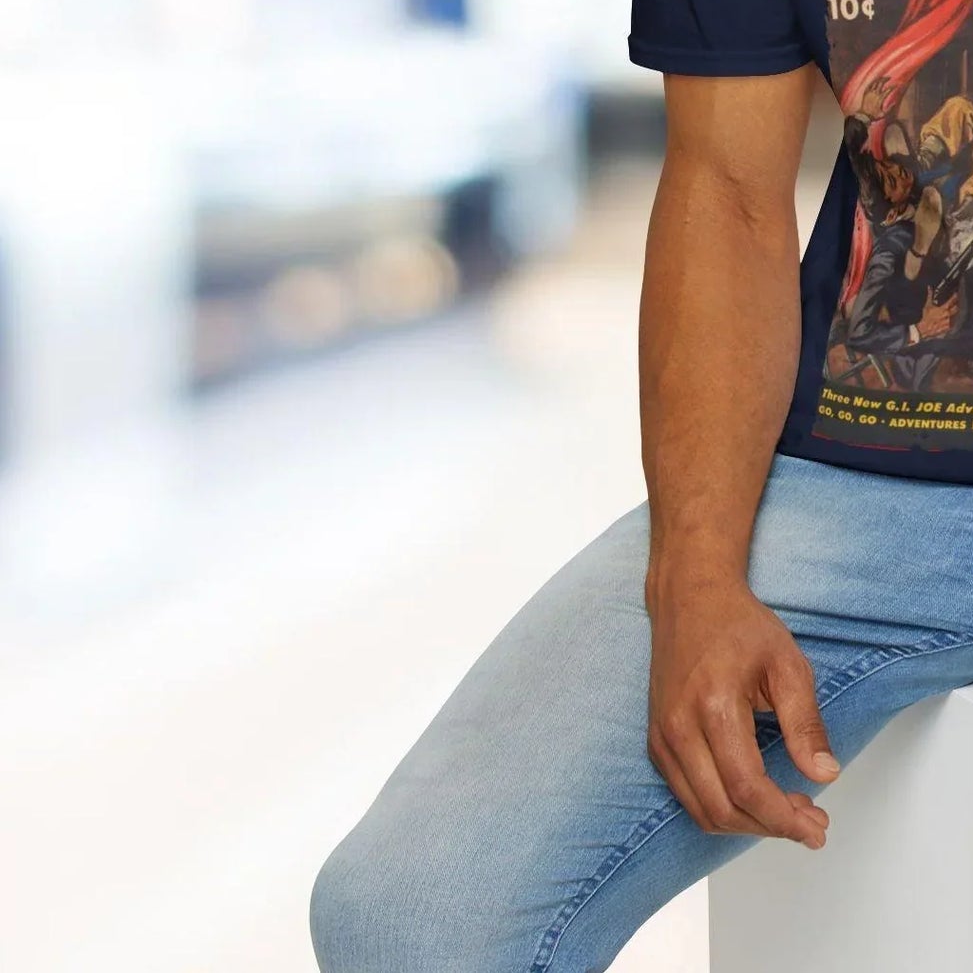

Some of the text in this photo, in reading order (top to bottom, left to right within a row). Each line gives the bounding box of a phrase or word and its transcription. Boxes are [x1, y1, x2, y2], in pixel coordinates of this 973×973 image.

[822, 388, 850, 405] Three
[853, 396, 881, 409] New
[916, 402, 943, 413] JOE
[818, 405, 834, 418] GO,
[838, 410, 854, 423] GO,
[859, 414, 877, 425] GO
[889, 418, 966, 430] ADVENTURES
